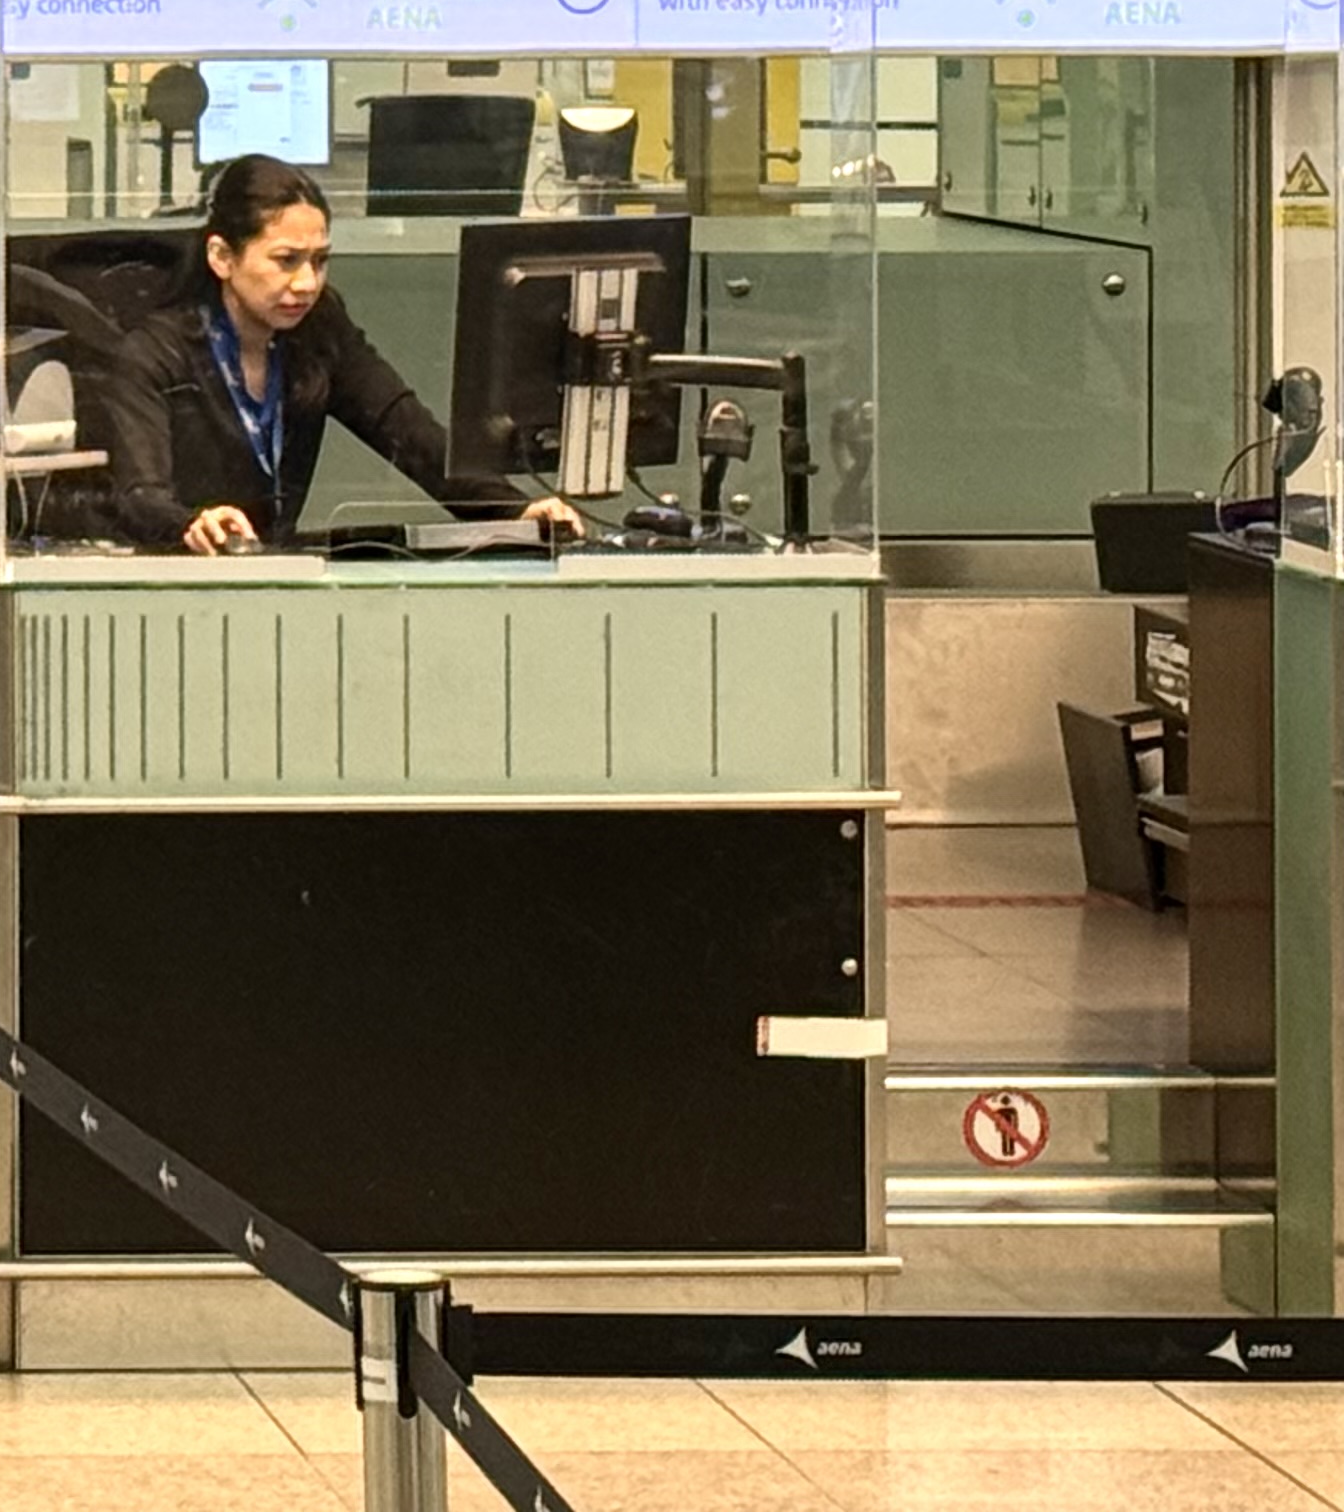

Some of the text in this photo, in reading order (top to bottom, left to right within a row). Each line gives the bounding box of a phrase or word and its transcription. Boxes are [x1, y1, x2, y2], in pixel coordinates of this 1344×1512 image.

[366, 7, 442, 30] AENA
[1105, 1, 1182, 24] AENA
[817, 1338, 863, 1356] aena
[1247, 1341, 1293, 1360] aena
